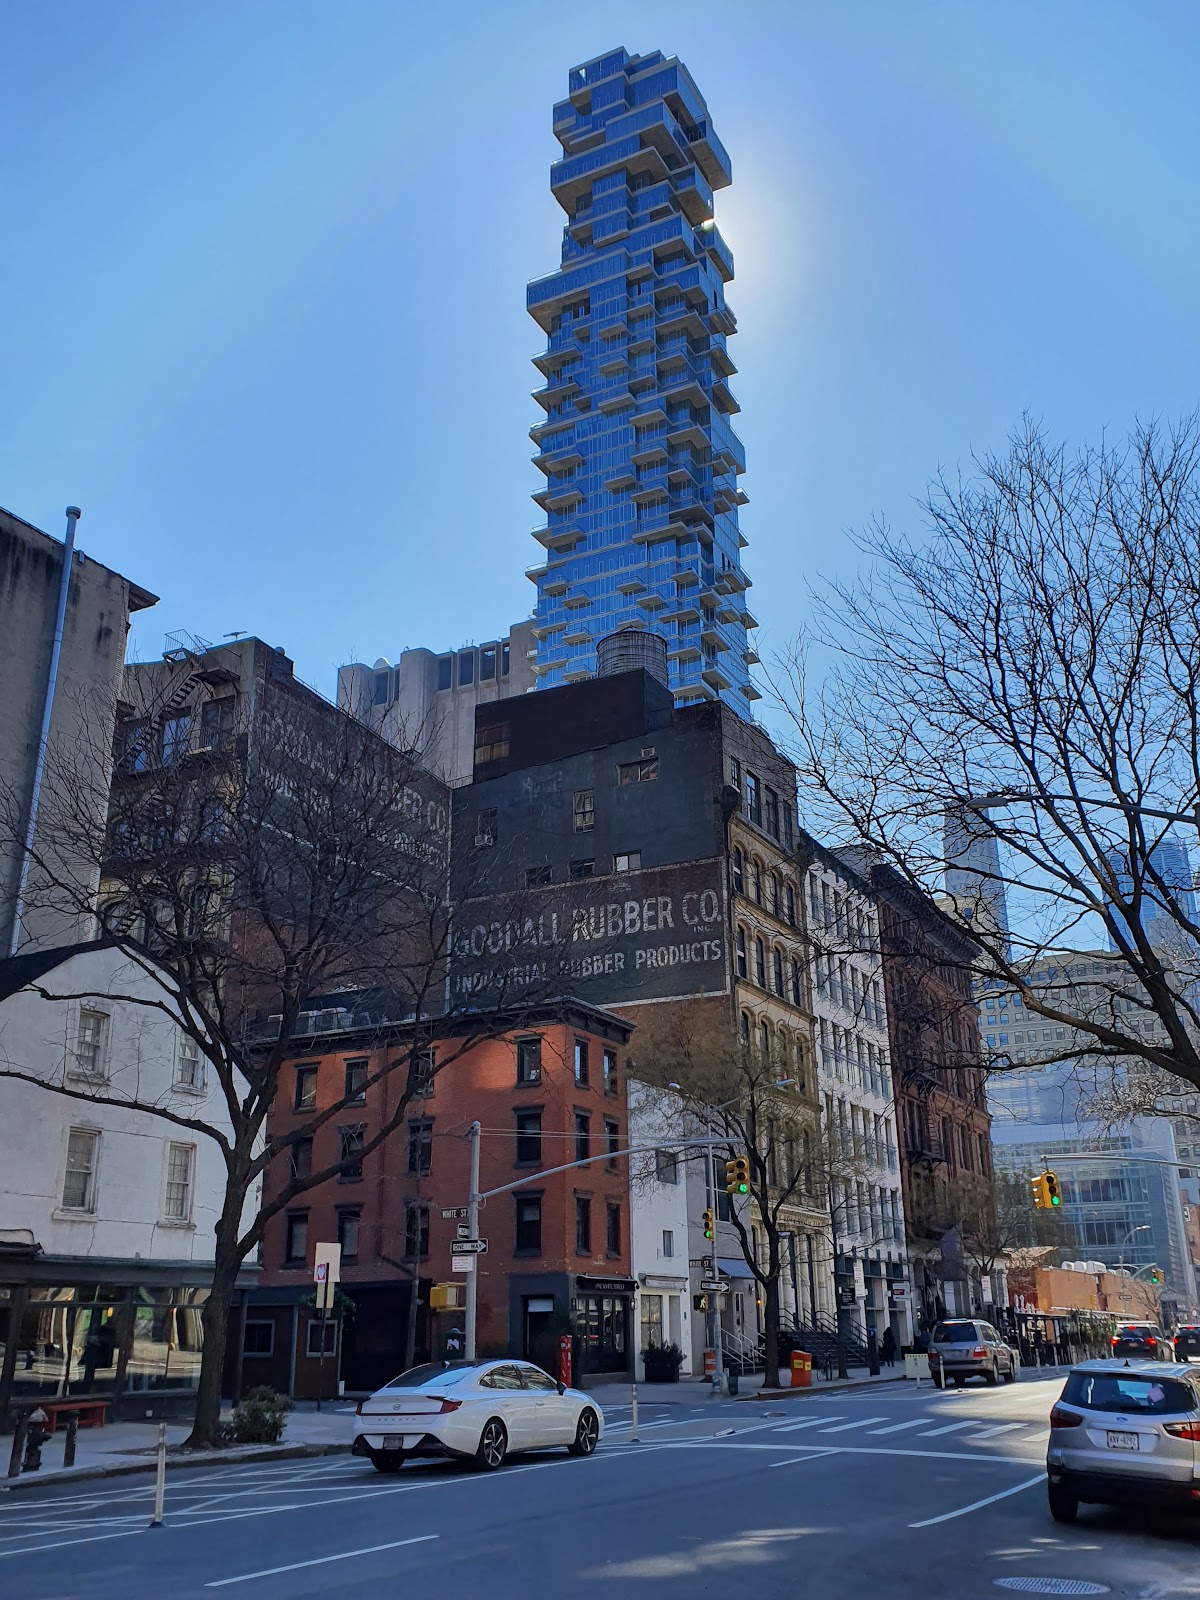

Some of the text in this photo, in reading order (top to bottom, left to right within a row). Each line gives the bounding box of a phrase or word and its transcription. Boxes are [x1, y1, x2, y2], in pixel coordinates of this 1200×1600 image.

[572, 896, 674, 942] RUBBER
[559, 952, 626, 978] RUBBER
[635, 940, 722, 970] PRODUCTS
[442, 1209, 467, 1218] WHITE ST
